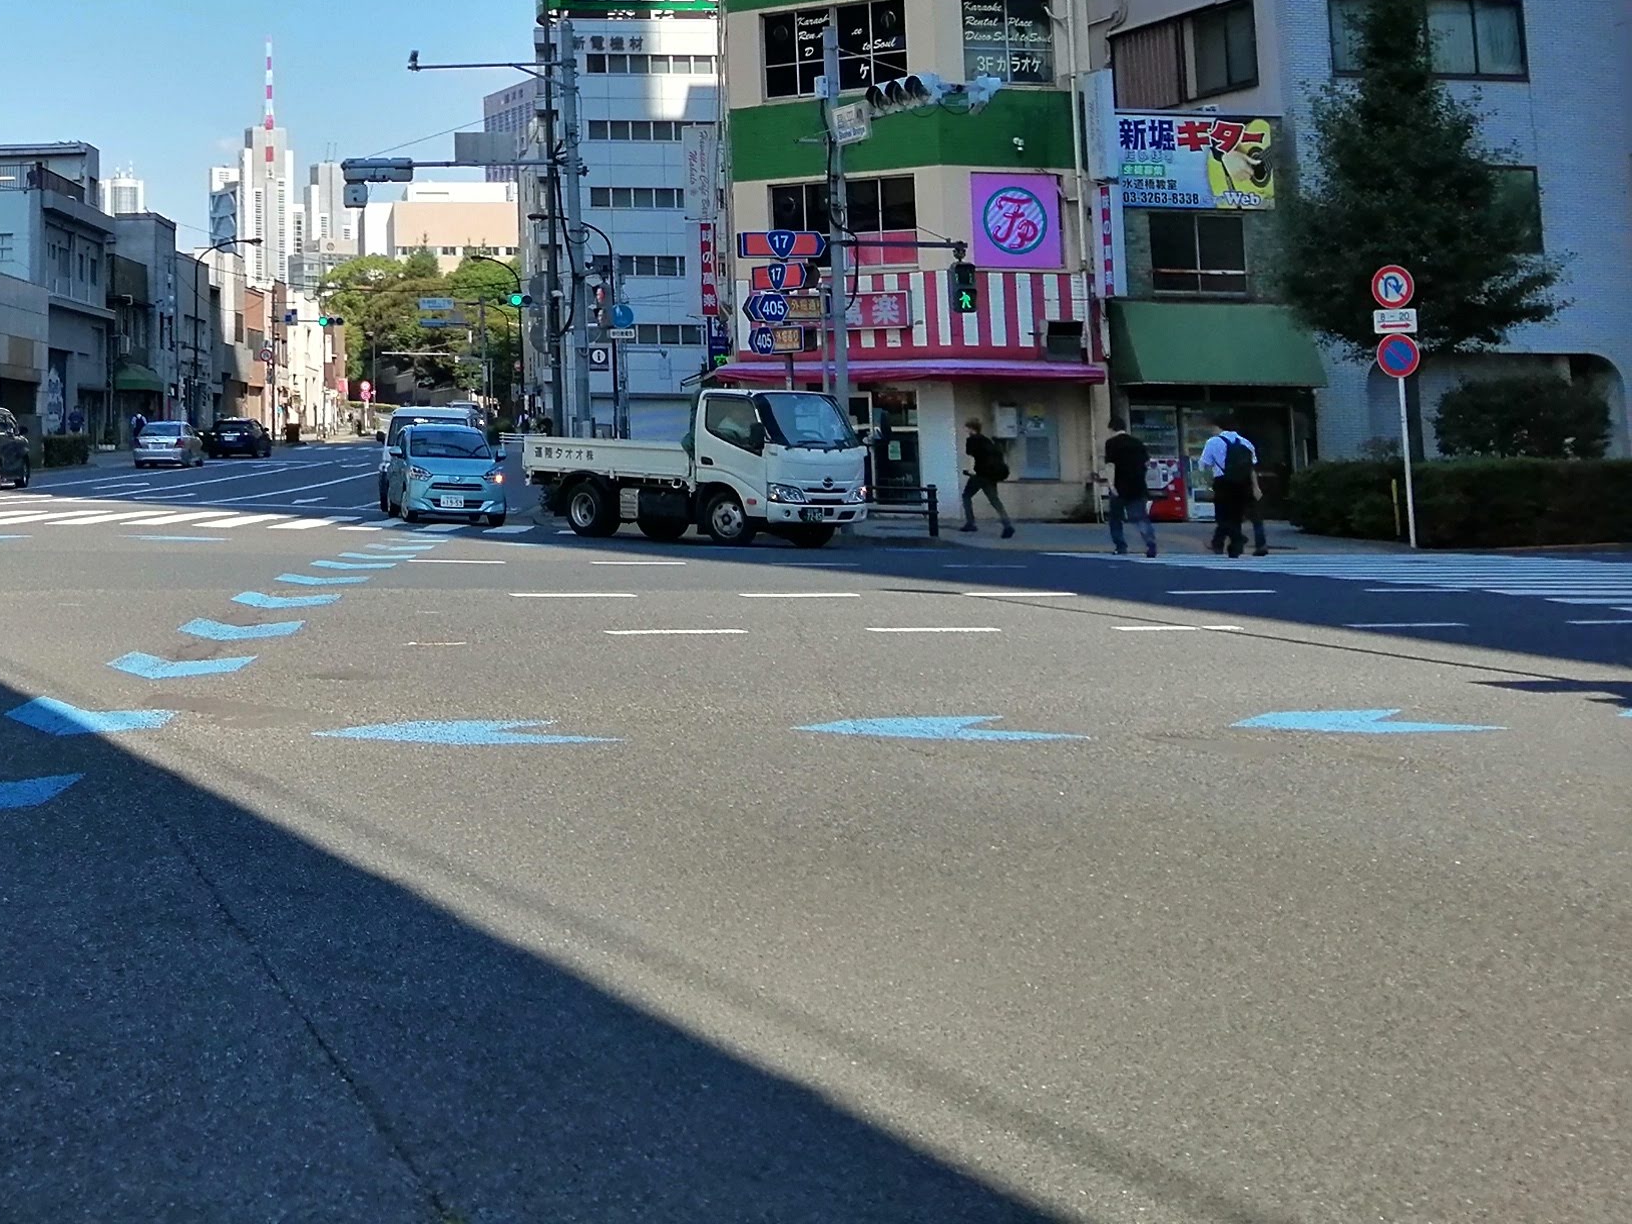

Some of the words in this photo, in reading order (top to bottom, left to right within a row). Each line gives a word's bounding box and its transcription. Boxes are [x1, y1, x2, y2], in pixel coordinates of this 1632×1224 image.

[963, 1, 1002, 12] Karaoke
[964, 16, 998, 27] Rental
[1008, 17, 1033, 27] Place
[964, 31, 992, 41] Disco
[873, 36, 897, 50] Soul
[1119, 117, 1265, 154] 新堀ギター
[1122, 178, 1178, 191] 水道橋教室
[1122, 191, 1200, 205] 03-3263-8338
[1223, 190, 1261, 207] Web
[772, 235, 789, 249] 17
[770, 267, 782, 278] 17
[762, 302, 785, 315] 405
[756, 333, 772, 348] 405
